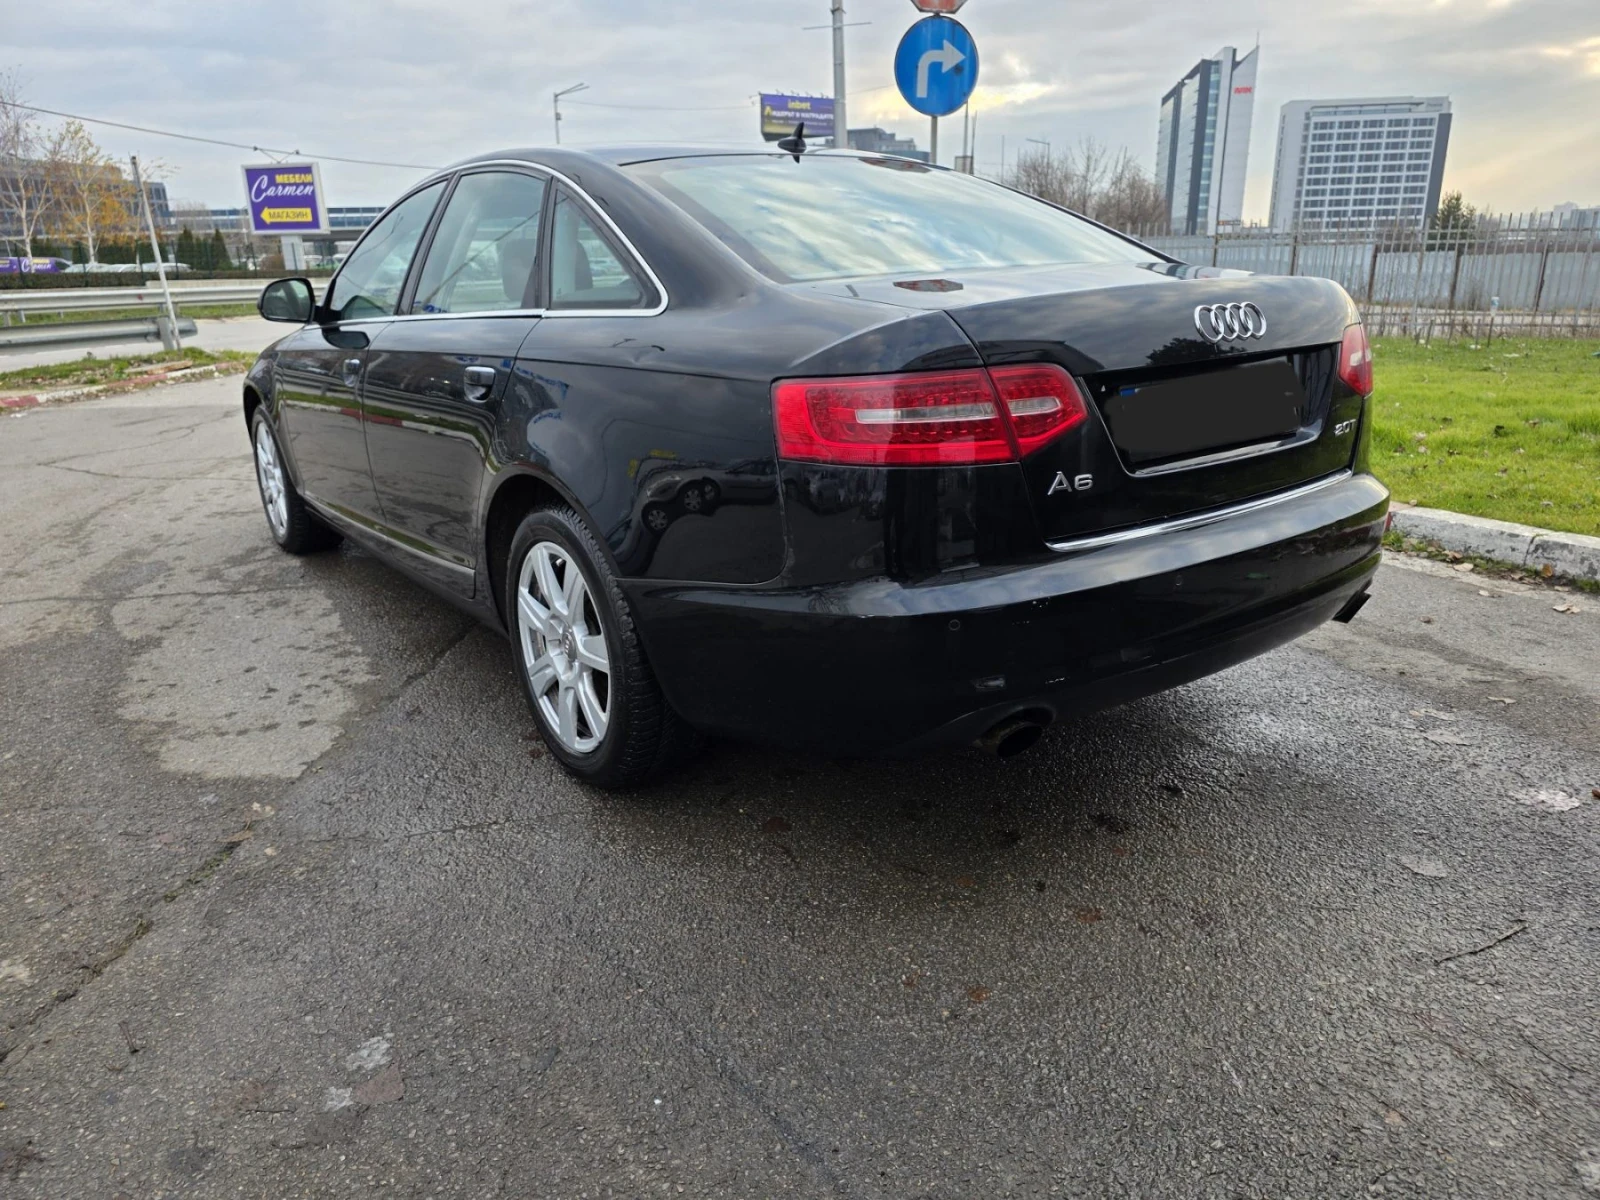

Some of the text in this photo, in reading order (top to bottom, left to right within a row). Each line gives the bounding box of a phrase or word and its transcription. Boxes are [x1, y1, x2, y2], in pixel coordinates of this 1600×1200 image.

[275, 173, 313, 184] МЕБЕЛИ
[251, 174, 314, 202] Carmen
[268, 210, 308, 219] МАГАЗИН
[1047, 470, 1093, 496] A6
